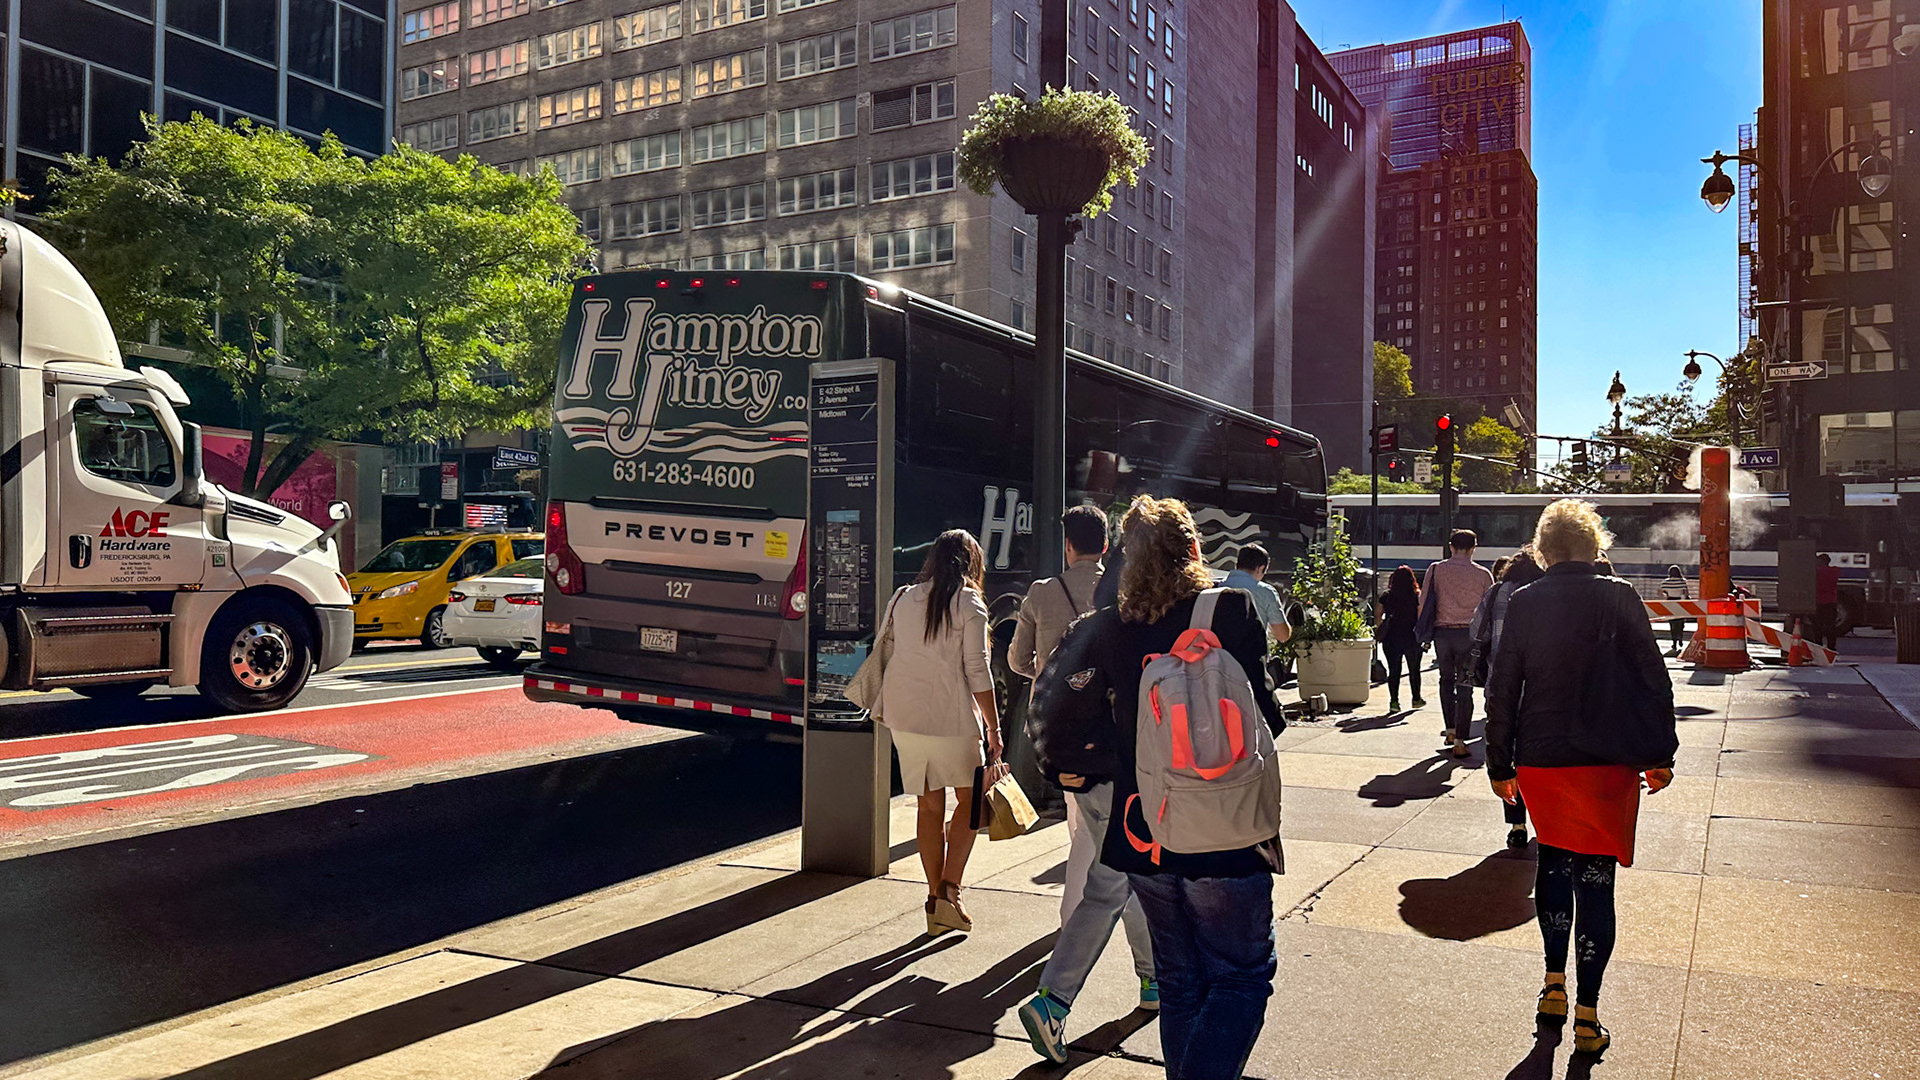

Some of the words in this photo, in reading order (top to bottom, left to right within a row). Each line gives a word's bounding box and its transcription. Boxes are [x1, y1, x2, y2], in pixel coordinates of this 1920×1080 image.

[1427, 62, 1524, 97] TUDOR
[1441, 96, 1508, 126] CITY
[564, 298, 823, 400] Hampton
[819, 387, 824, 396] E
[834, 386, 854, 394] Street
[606, 351, 782, 458] Jitney
[778, 396, 808, 410] .co
[819, 410, 846, 418] Midtown
[500, 450, 514, 459] East
[515, 452, 529, 462] 42nd
[530, 454, 537, 463] St
[1751, 454, 1773, 464] Ave
[612, 460, 755, 489] 631-283-4600
[268, 499, 302, 511] World
[98, 506, 170, 538] ACE
[100, 540, 171, 551] Hardware
[604, 521, 754, 548] PREVOST
[665, 581, 692, 598] 127
